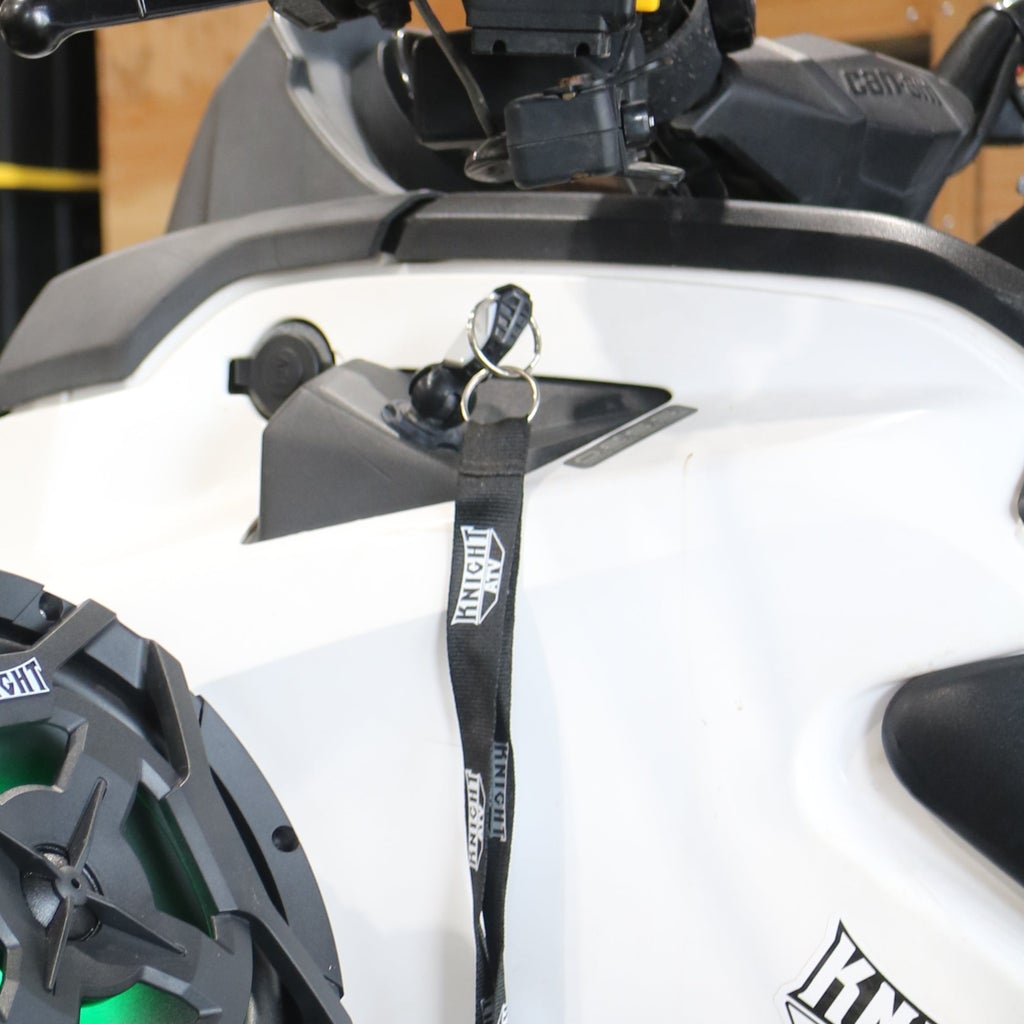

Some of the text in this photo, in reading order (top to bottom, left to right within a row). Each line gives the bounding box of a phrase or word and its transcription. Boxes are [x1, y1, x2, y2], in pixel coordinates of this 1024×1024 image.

[454, 527, 489, 621] KNIGHT
[484, 558, 501, 594] ATV
[466, 771, 480, 868] KNIGHT
[493, 742, 508, 838] KNIGHT
